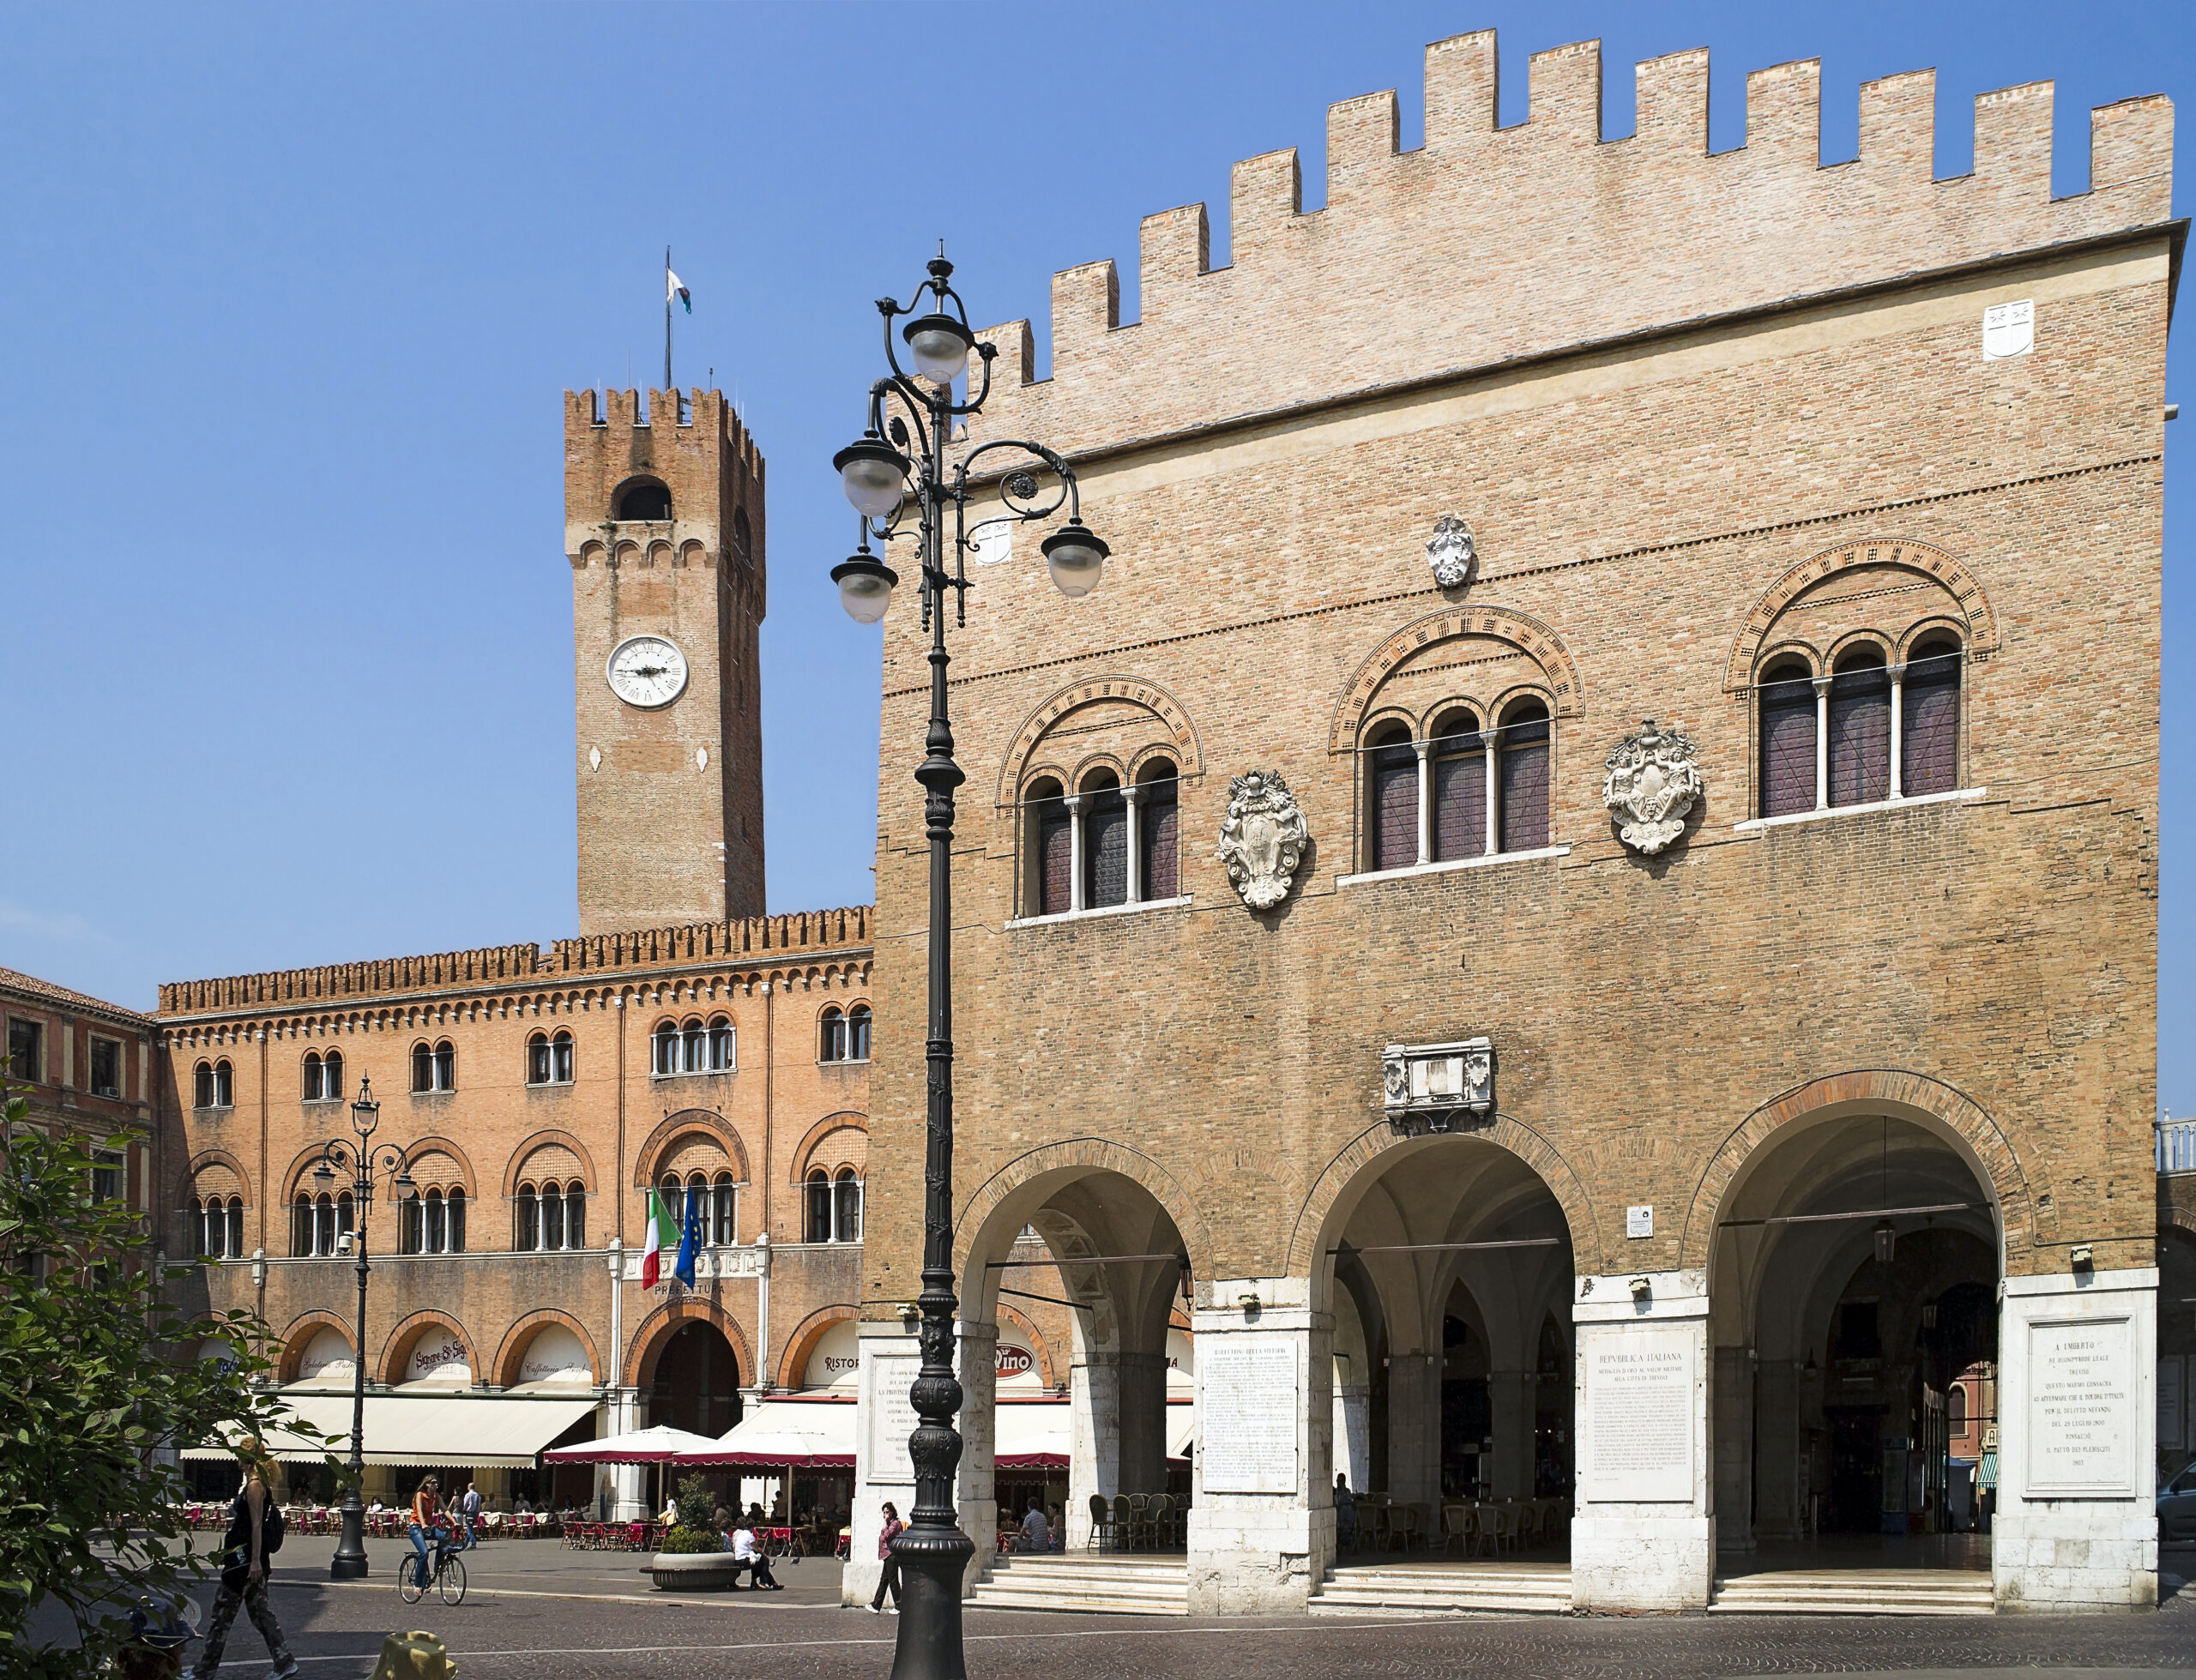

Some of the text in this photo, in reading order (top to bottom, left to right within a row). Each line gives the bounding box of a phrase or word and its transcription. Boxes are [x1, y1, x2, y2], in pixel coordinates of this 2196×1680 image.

[1599, 1352, 1682, 1364] REPVBBLICA ITALIANA
[526, 1360, 559, 1376] Caffetteria
